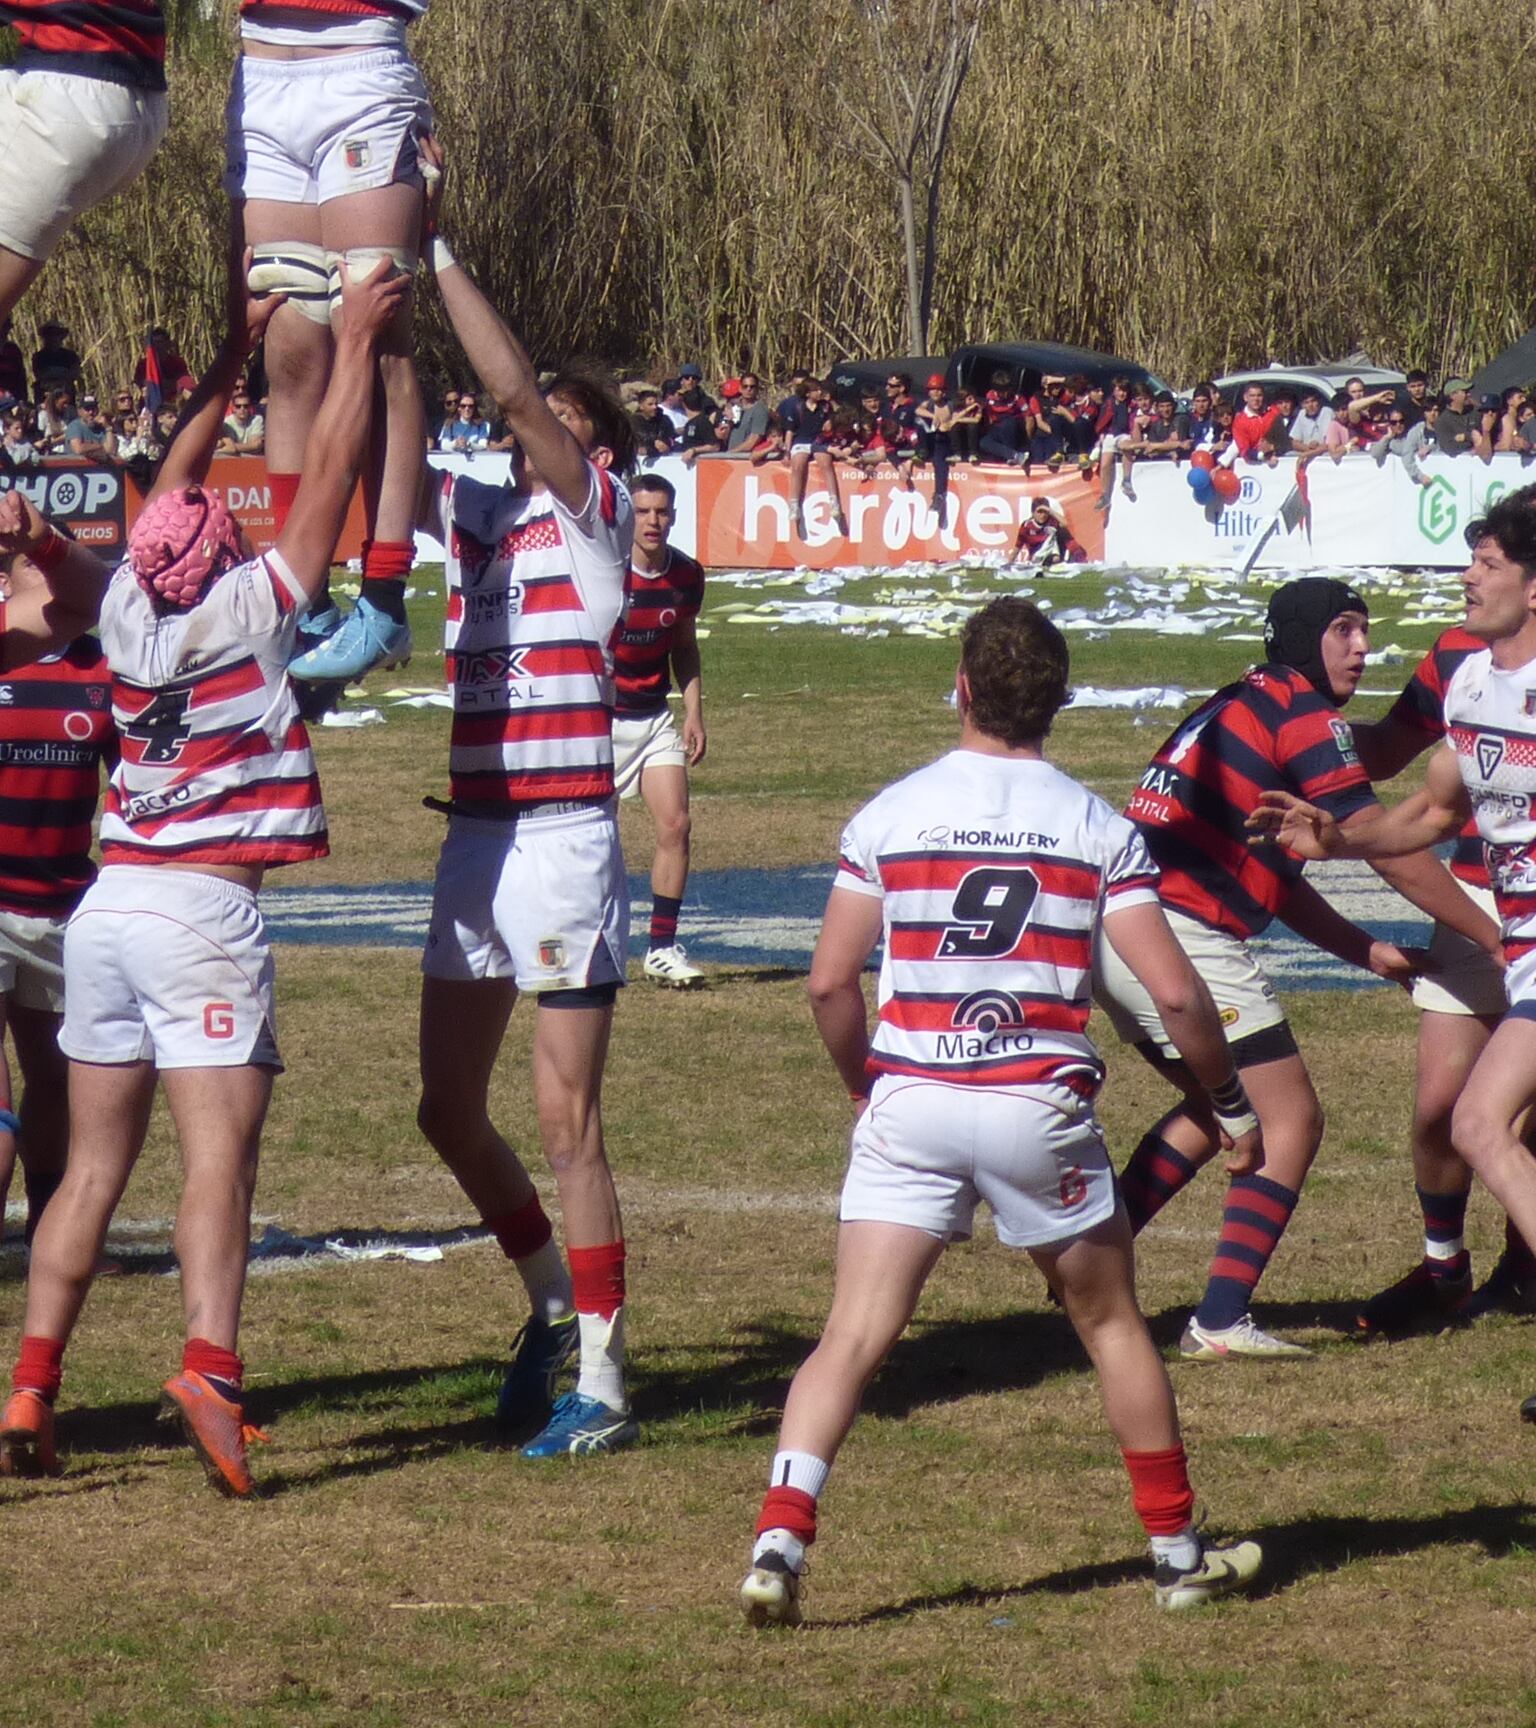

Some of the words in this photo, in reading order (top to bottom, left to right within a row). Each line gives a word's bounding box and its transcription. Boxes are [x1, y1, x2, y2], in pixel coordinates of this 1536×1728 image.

[124, 688, 194, 765] 4
[953, 830, 1060, 849] HORMISERV
[933, 865, 1042, 960] 9
[203, 1002, 234, 1039] G
[936, 1033, 1034, 1060] Macro
